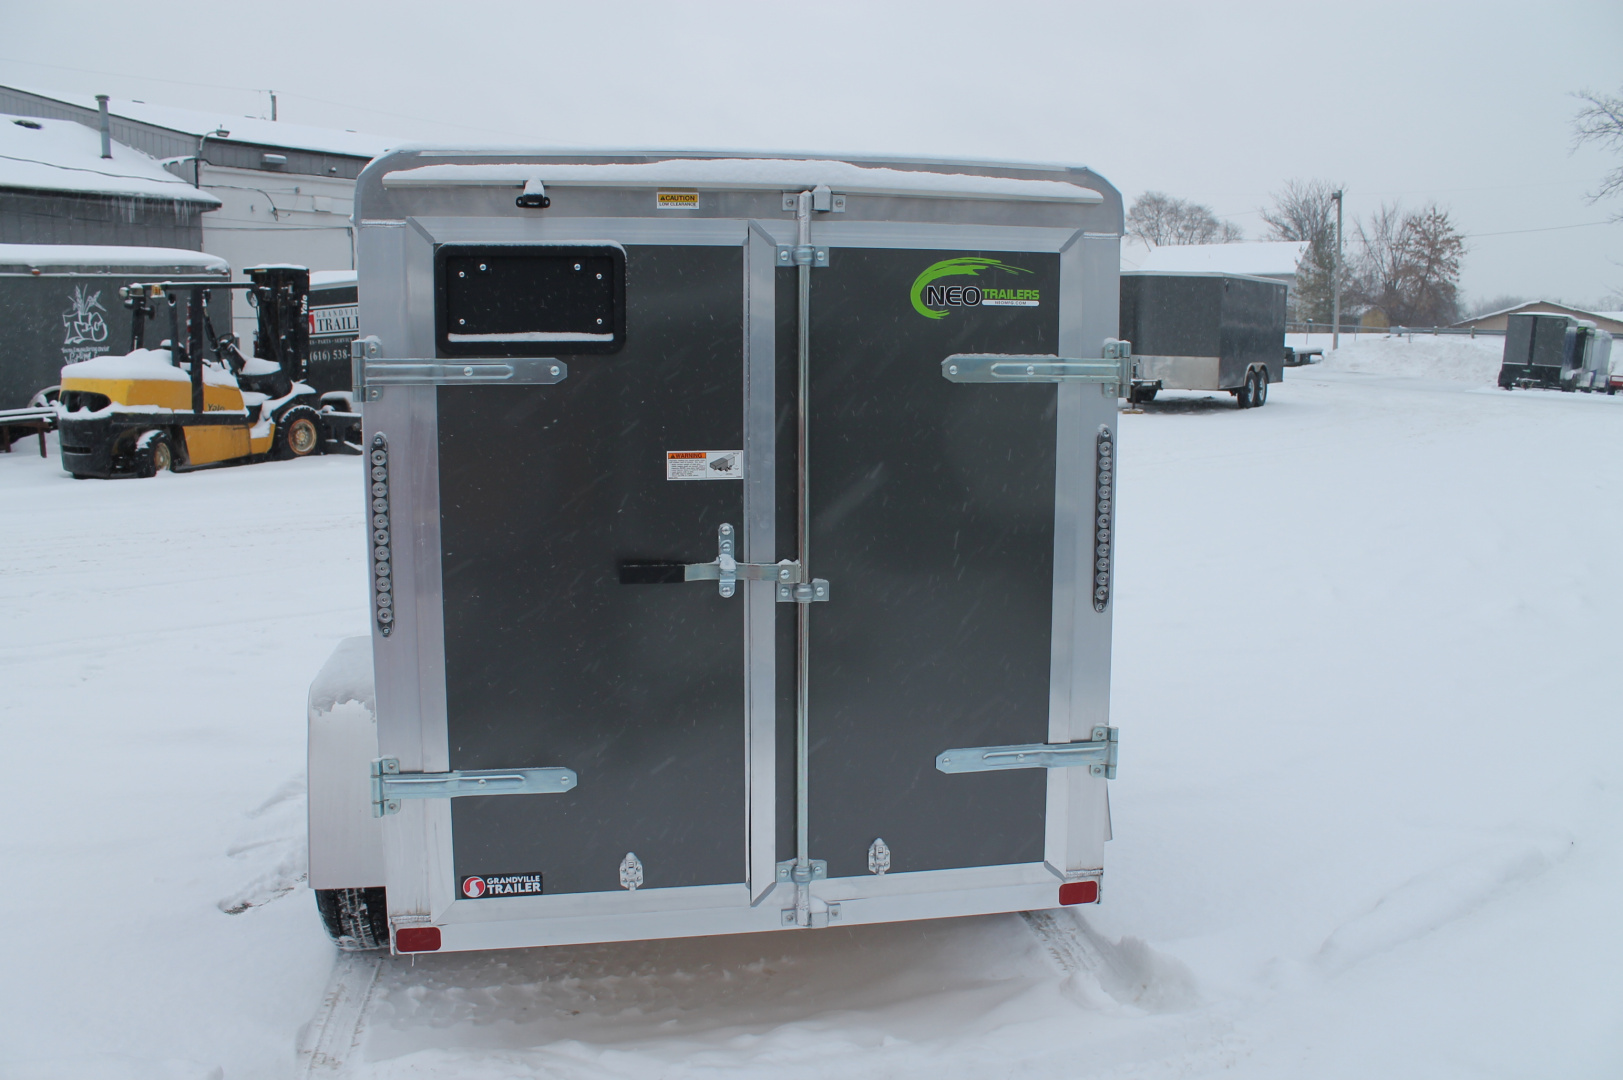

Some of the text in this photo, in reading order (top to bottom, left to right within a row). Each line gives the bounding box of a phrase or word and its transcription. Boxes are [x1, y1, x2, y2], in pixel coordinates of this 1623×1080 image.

[926, 285, 1040, 306] NEO TRAILERS
[309, 351, 331, 363] (616)
[486, 875, 540, 885] GRANDVILLE
[487, 882, 541, 894] TRAILER
